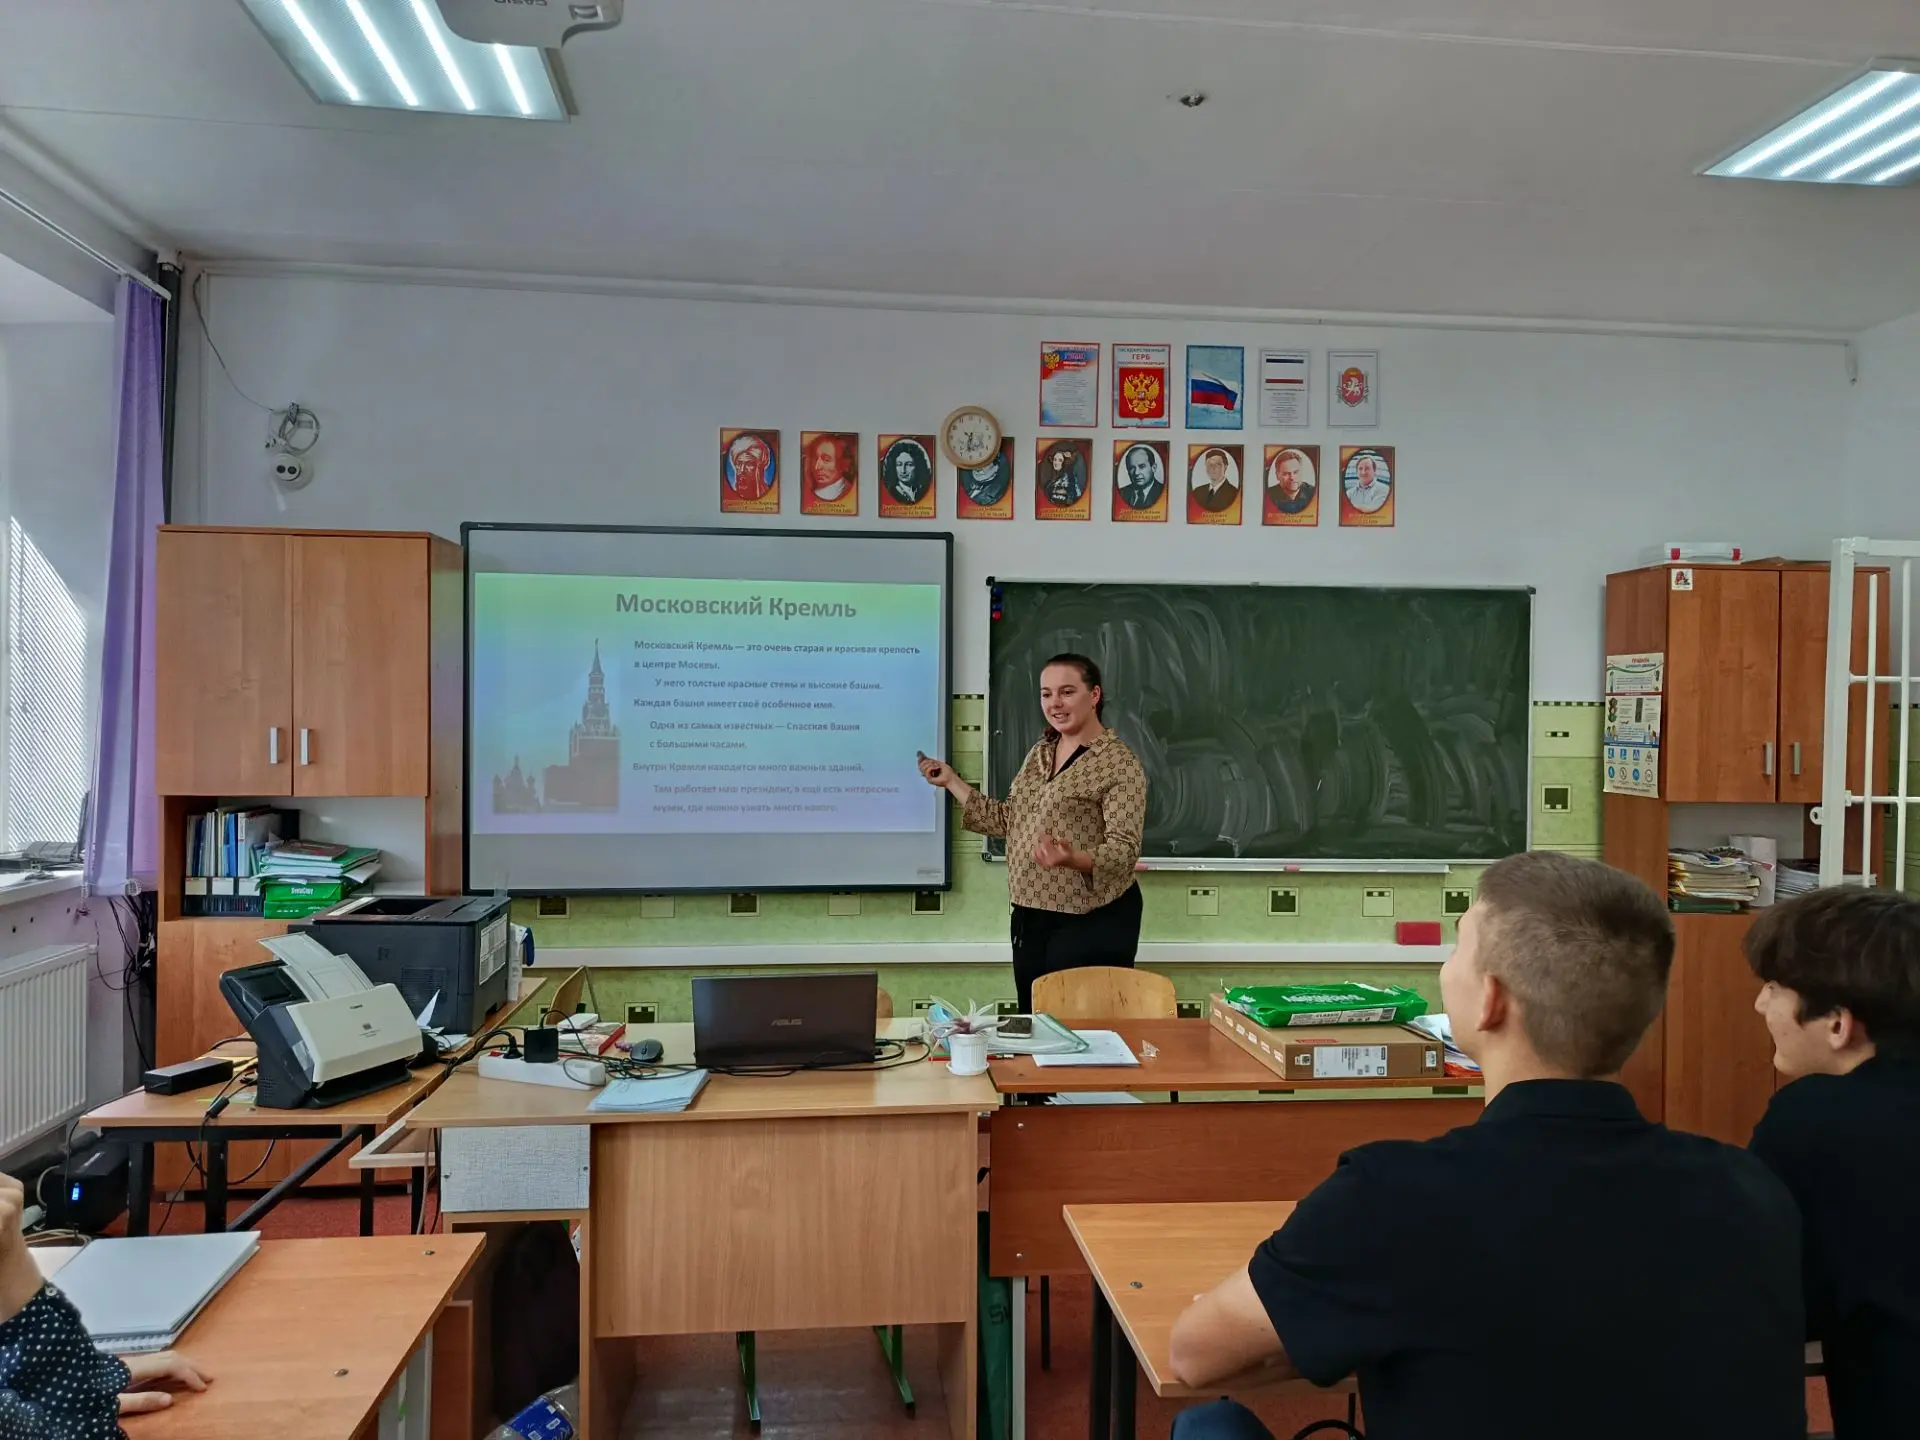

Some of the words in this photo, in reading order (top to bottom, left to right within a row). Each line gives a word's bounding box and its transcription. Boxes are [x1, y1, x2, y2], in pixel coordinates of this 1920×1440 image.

[616, 593, 762, 616] Московский
[769, 598, 857, 620] Кремль
[634, 640, 694, 650] Московский
[696, 642, 734, 652] Кремль
[794, 646, 824, 654] старая
[834, 646, 877, 654] красивая
[878, 647, 920, 656] крепость
[642, 661, 676, 670] центре
[678, 660, 720, 670] Москвы.
[654, 678, 662, 688] У
[664, 680, 686, 688] него
[688, 680, 727, 688] толстые
[728, 681, 768, 690] красные
[634, 698, 671, 708] Каждая
[762, 700, 812, 710] особенное
[650, 720, 674, 730] Одна
[786, 722, 828, 731] Спасская
[830, 723, 860, 732] башня
[656, 740, 708, 748] большими
[632, 762, 667, 773] Внутри
[670, 763, 707, 773] Кремля
[828, 763, 864, 772] зданий.
[674, 785, 716, 794] работает
[770, 1018, 804, 1026] ASUS
